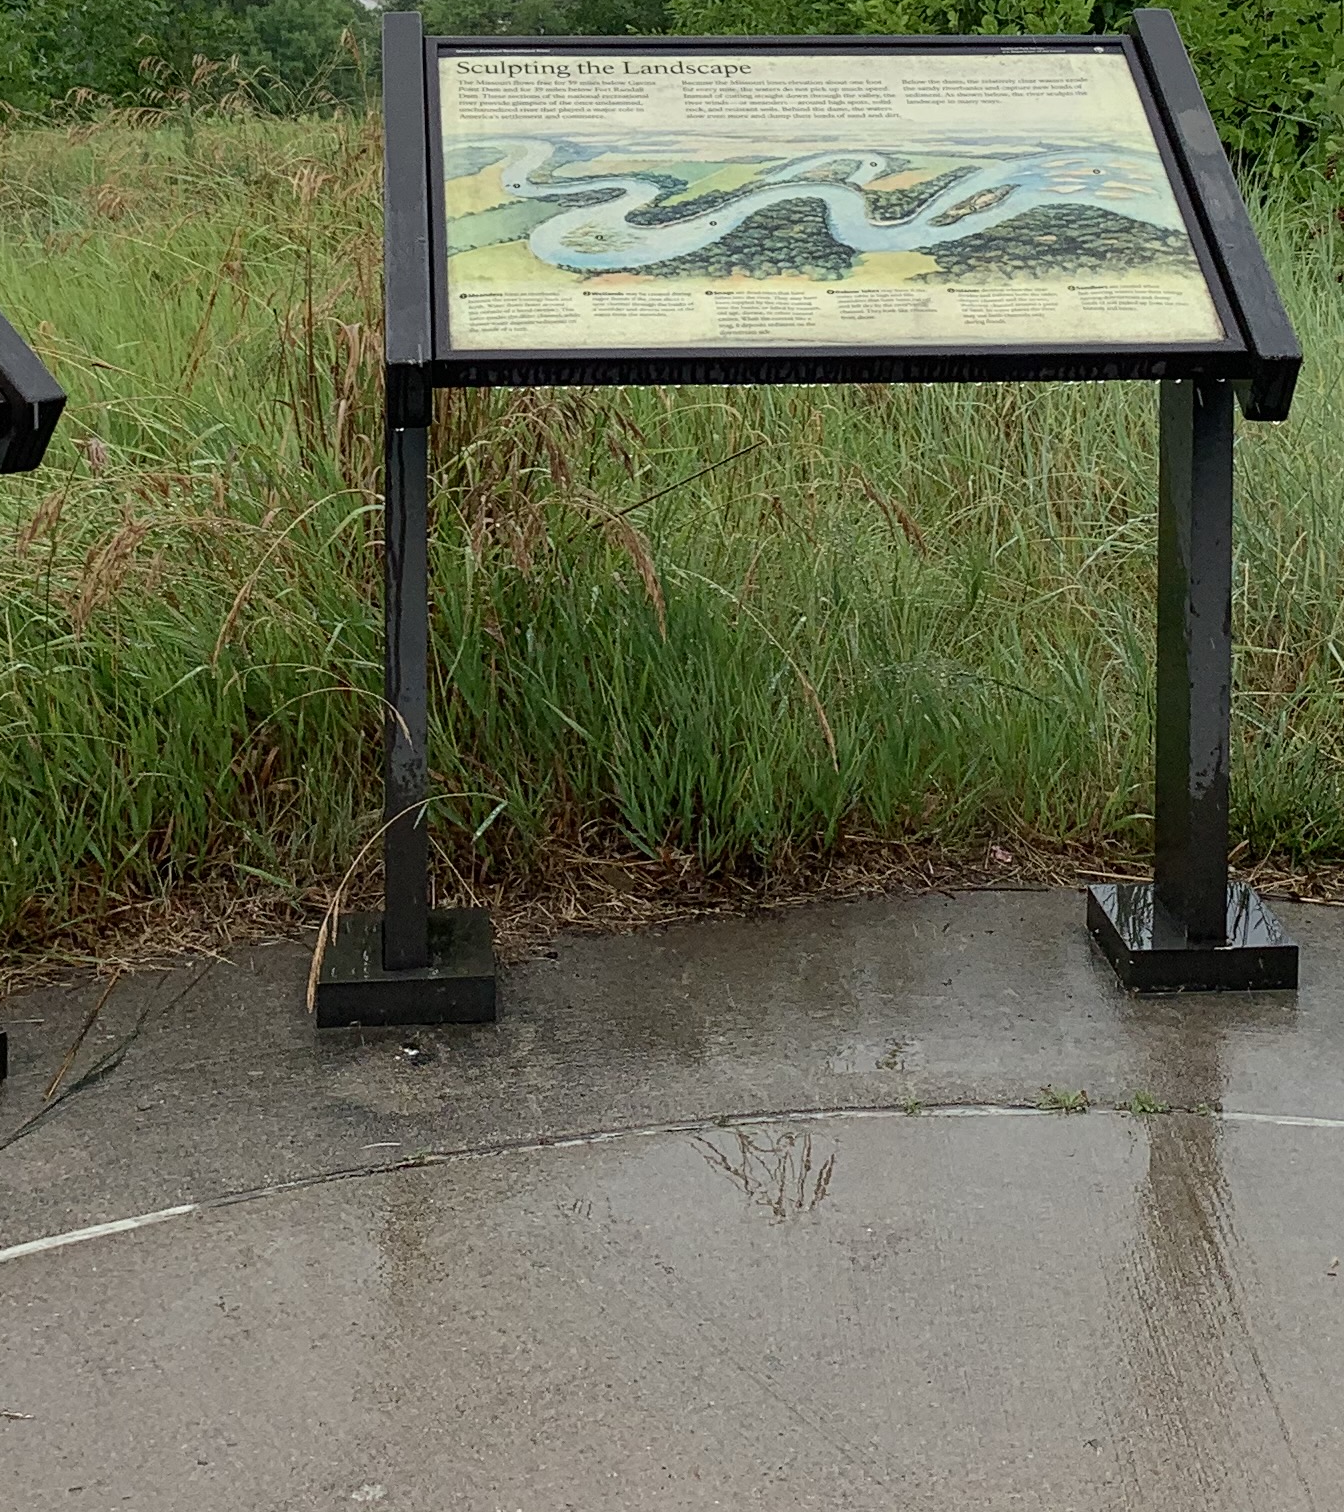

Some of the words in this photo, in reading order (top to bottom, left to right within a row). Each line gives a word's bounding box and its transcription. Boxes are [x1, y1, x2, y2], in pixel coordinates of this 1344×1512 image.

[456, 60, 570, 78] Sculpting
[578, 61, 614, 75] the
[623, 61, 752, 77] Landscape
